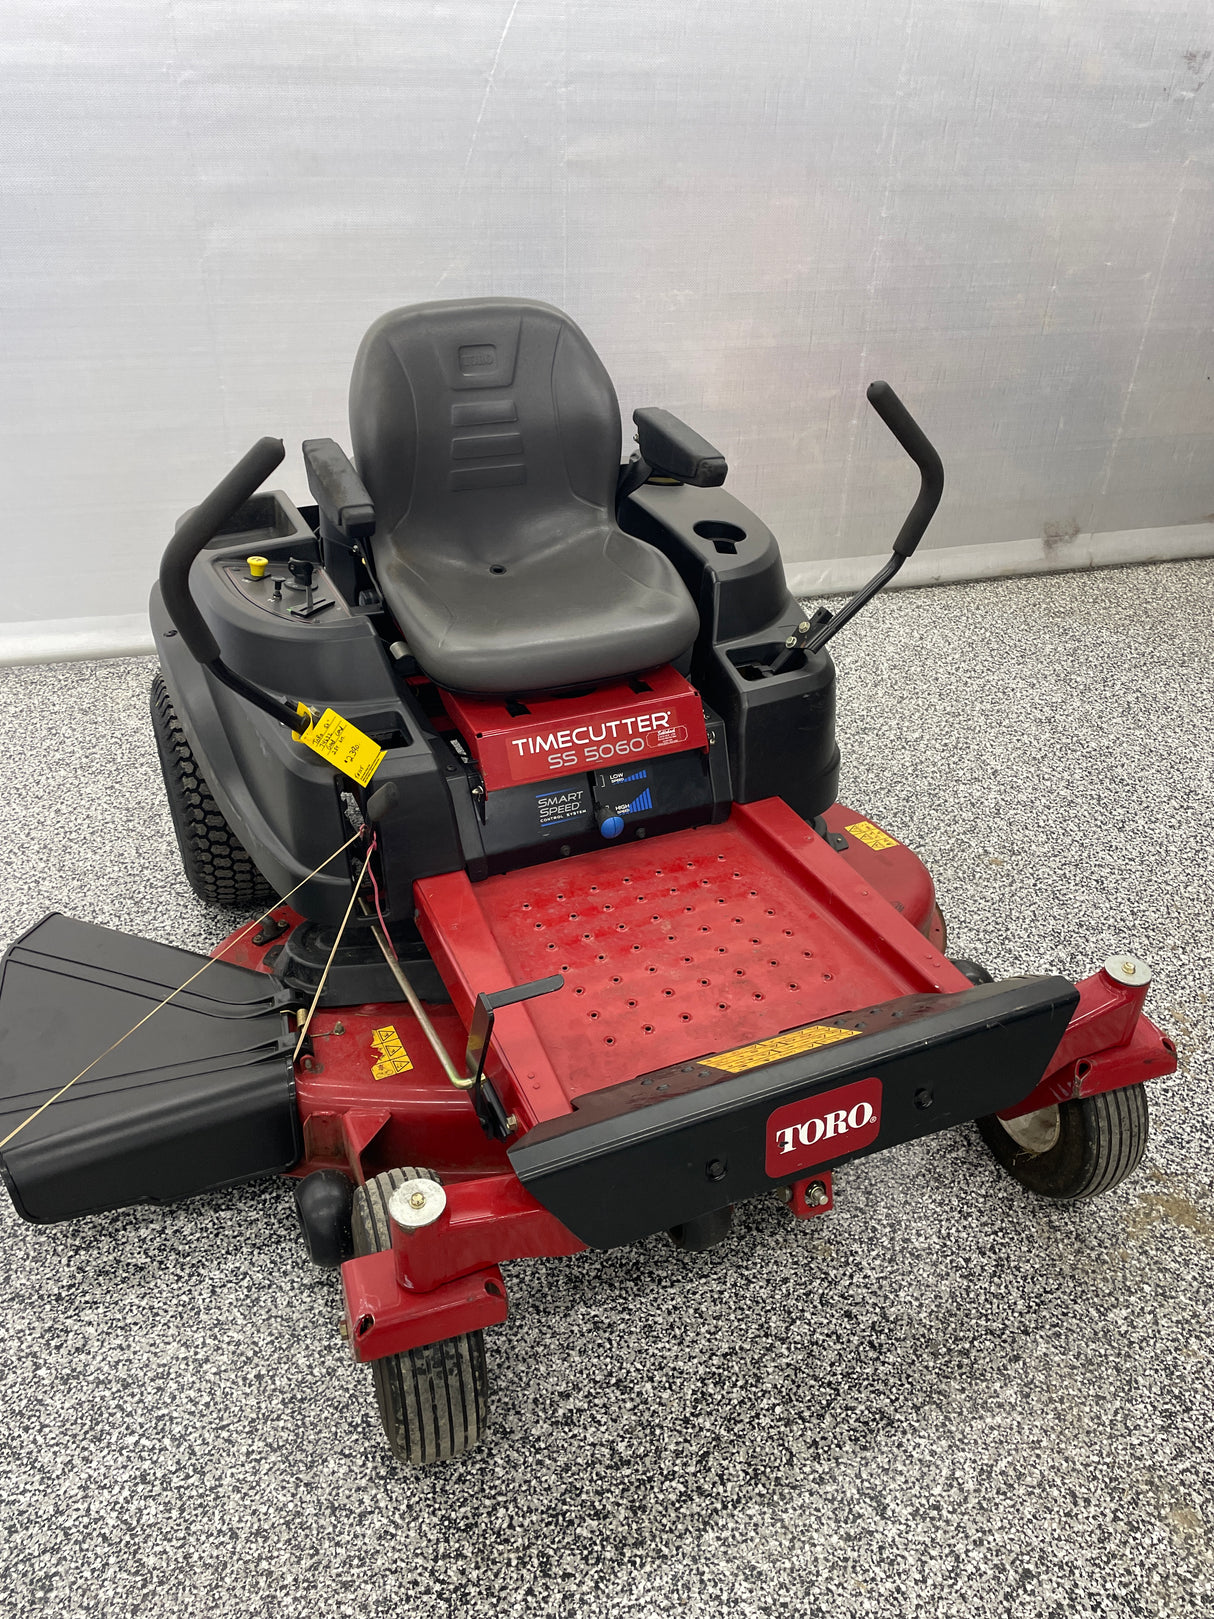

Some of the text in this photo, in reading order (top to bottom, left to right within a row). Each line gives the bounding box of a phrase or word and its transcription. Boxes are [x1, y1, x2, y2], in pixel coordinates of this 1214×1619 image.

[512, 711, 671, 756] TIMECUTTER
[548, 753, 578, 769] SS
[585, 737, 645, 762] 5060
[609, 772, 624, 780] LOW
[537, 790, 584, 809] SMART
[615, 803, 630, 811] HIGH
[539, 801, 581, 818] SPEED
[539, 809, 587, 823] CONTROL SYSTEM
[776, 1102, 873, 1155] TORO
